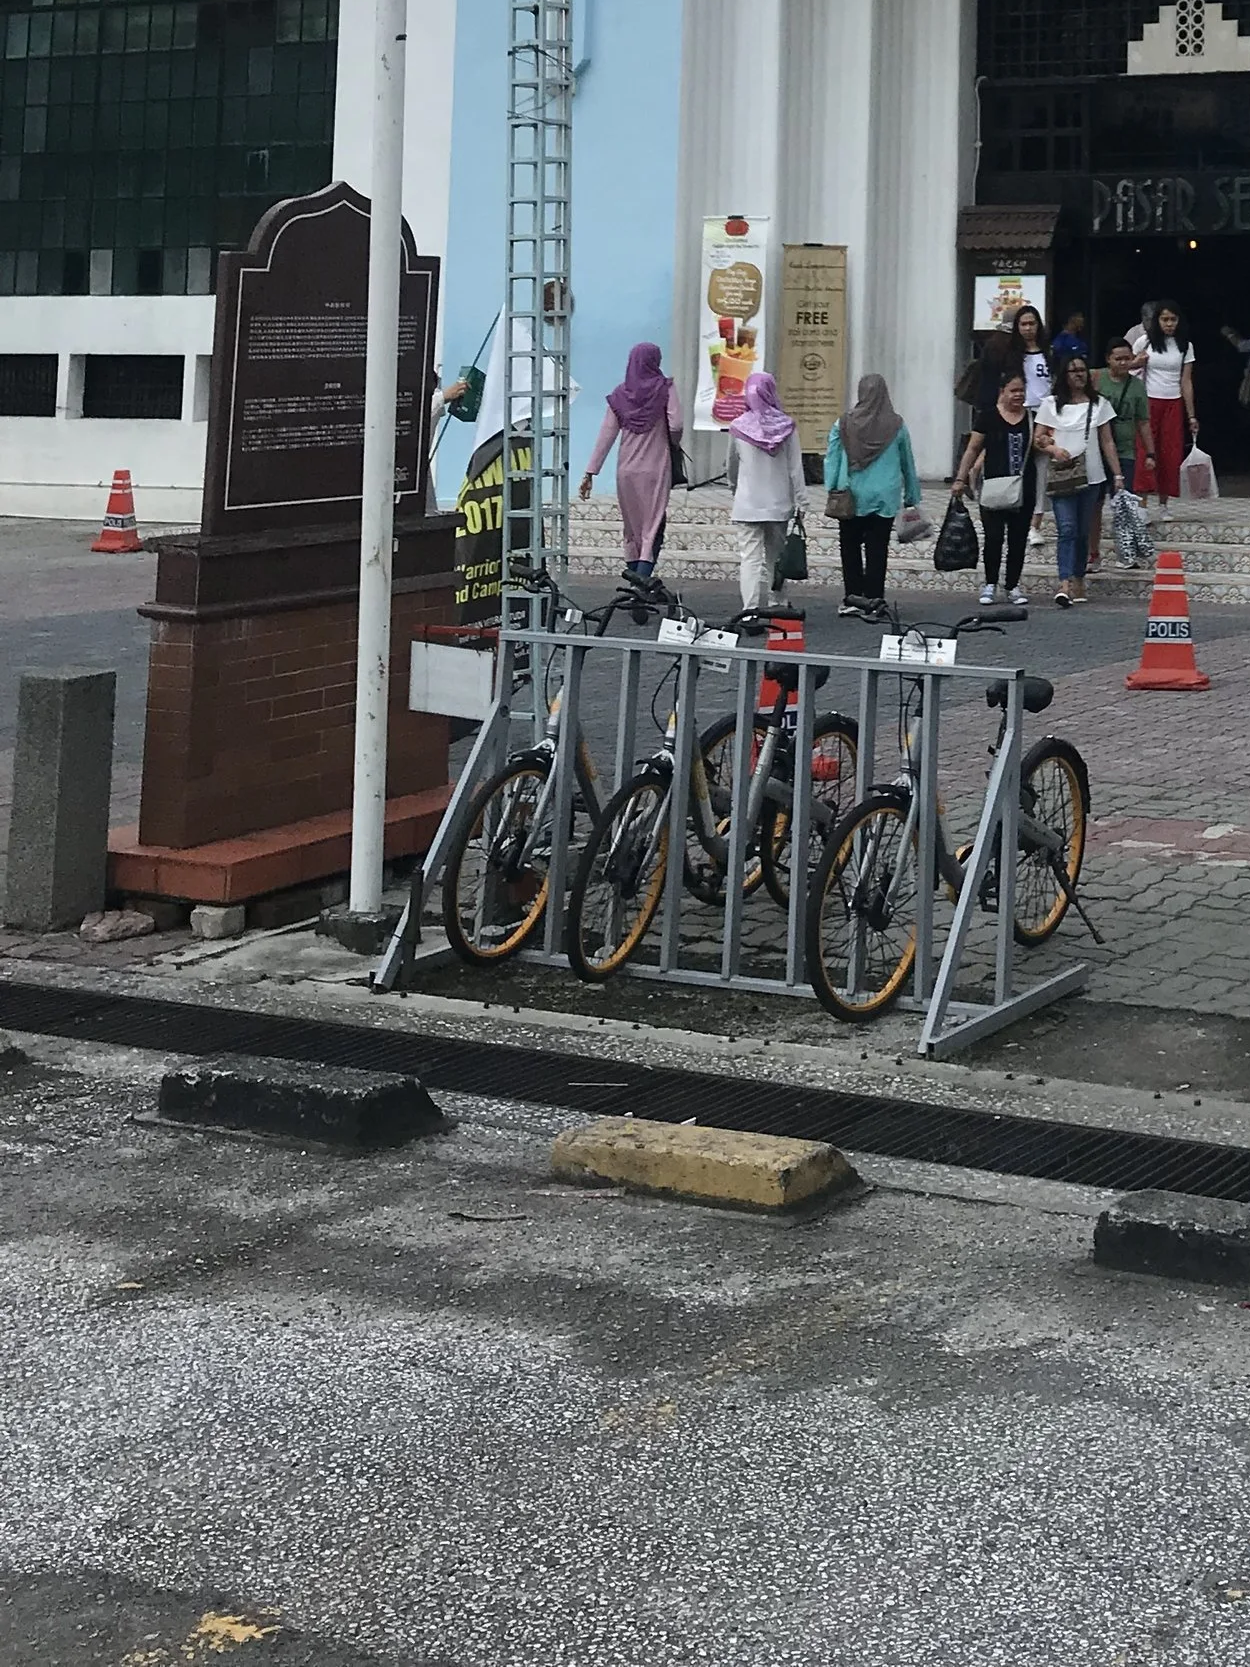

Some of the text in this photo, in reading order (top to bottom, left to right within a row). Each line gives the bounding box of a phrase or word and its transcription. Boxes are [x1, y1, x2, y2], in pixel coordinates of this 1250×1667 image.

[1092, 177, 1196, 232] PASAR
[796, 311, 829, 325] FREE
[1148, 622, 1190, 638] POLIS
